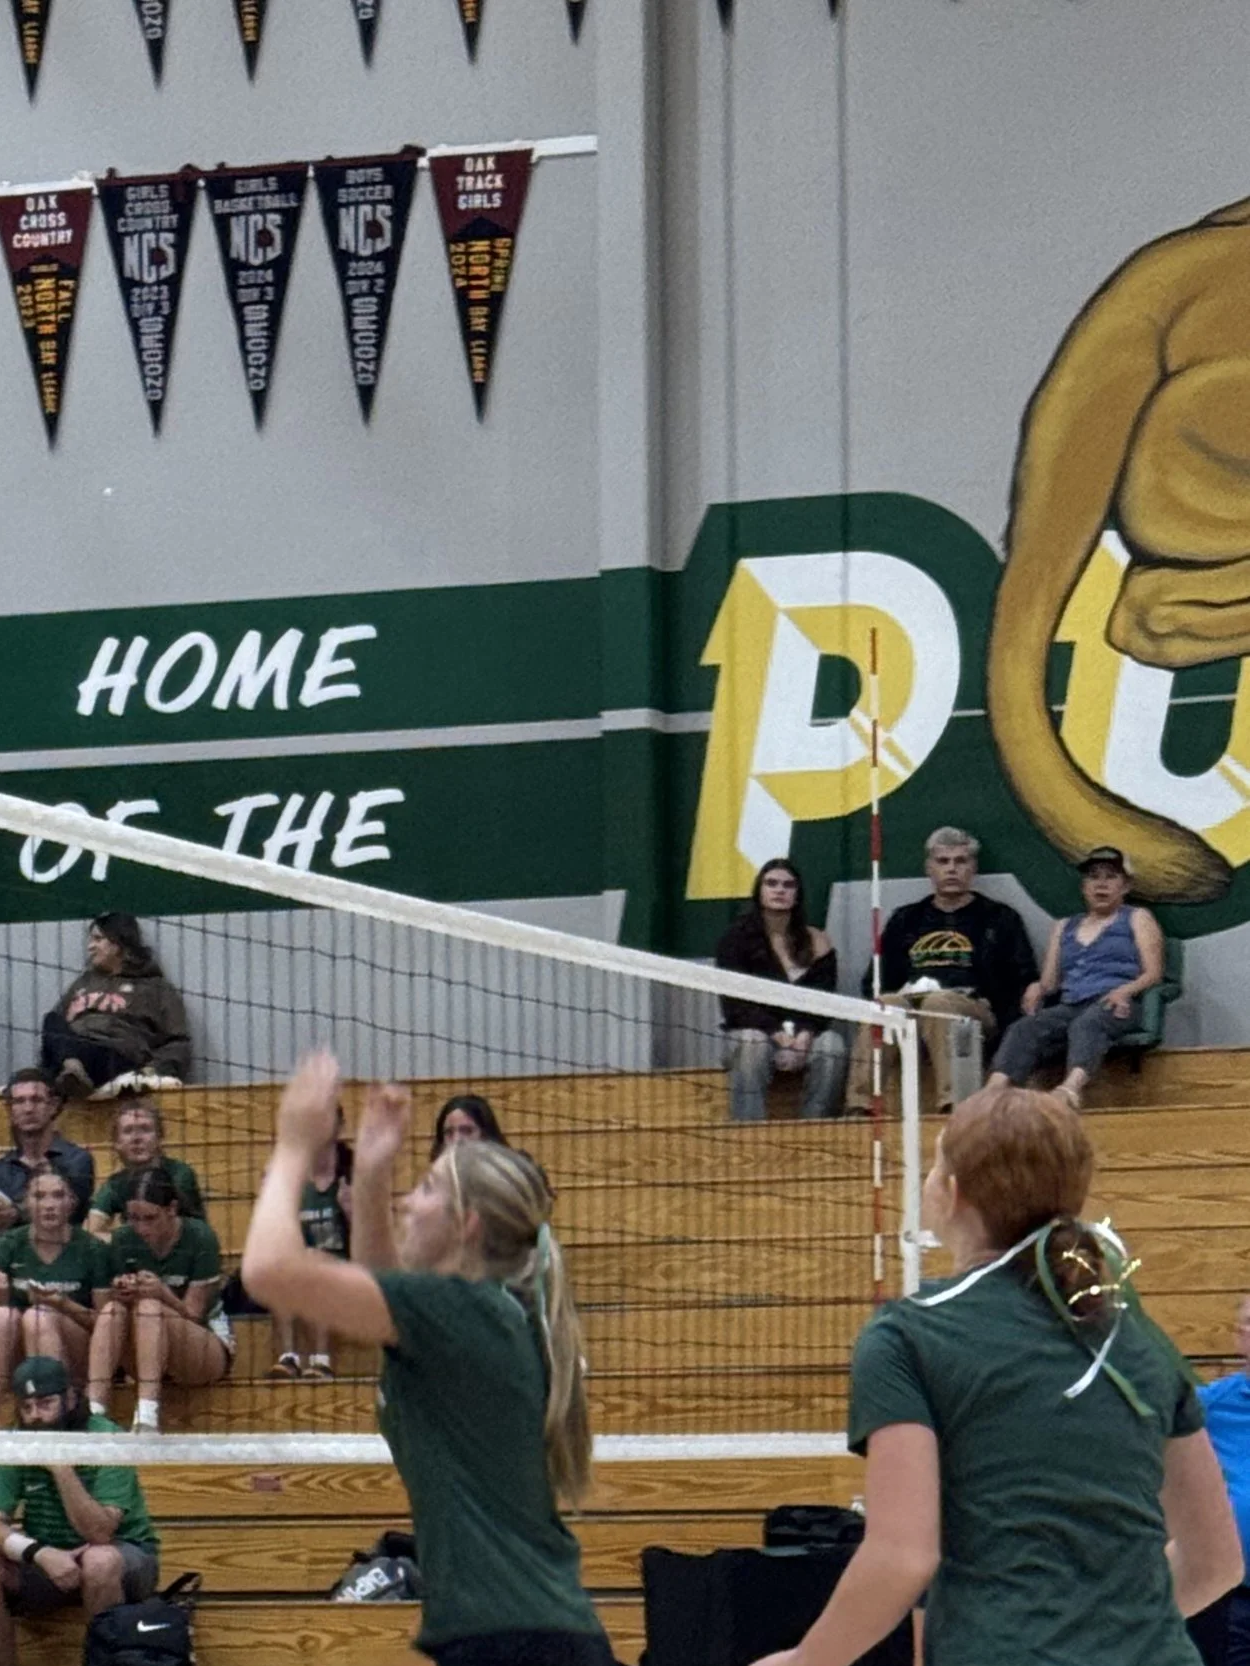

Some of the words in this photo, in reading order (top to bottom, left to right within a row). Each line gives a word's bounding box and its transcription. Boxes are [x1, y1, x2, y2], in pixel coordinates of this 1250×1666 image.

[464, 155, 497, 174] OAK
[455, 173, 505, 193] TRACK
[24, 194, 58, 212] OAK
[456, 192, 502, 211] GIRLS
[18, 211, 67, 231] CROSS
[337, 202, 393, 258] NCS
[11, 228, 74, 250] COUNTRY
[228, 212, 283, 267] NCS
[121, 231, 176, 285] NCS
[75, 623, 378, 717] HOME
[214, 787, 406, 872] THE
